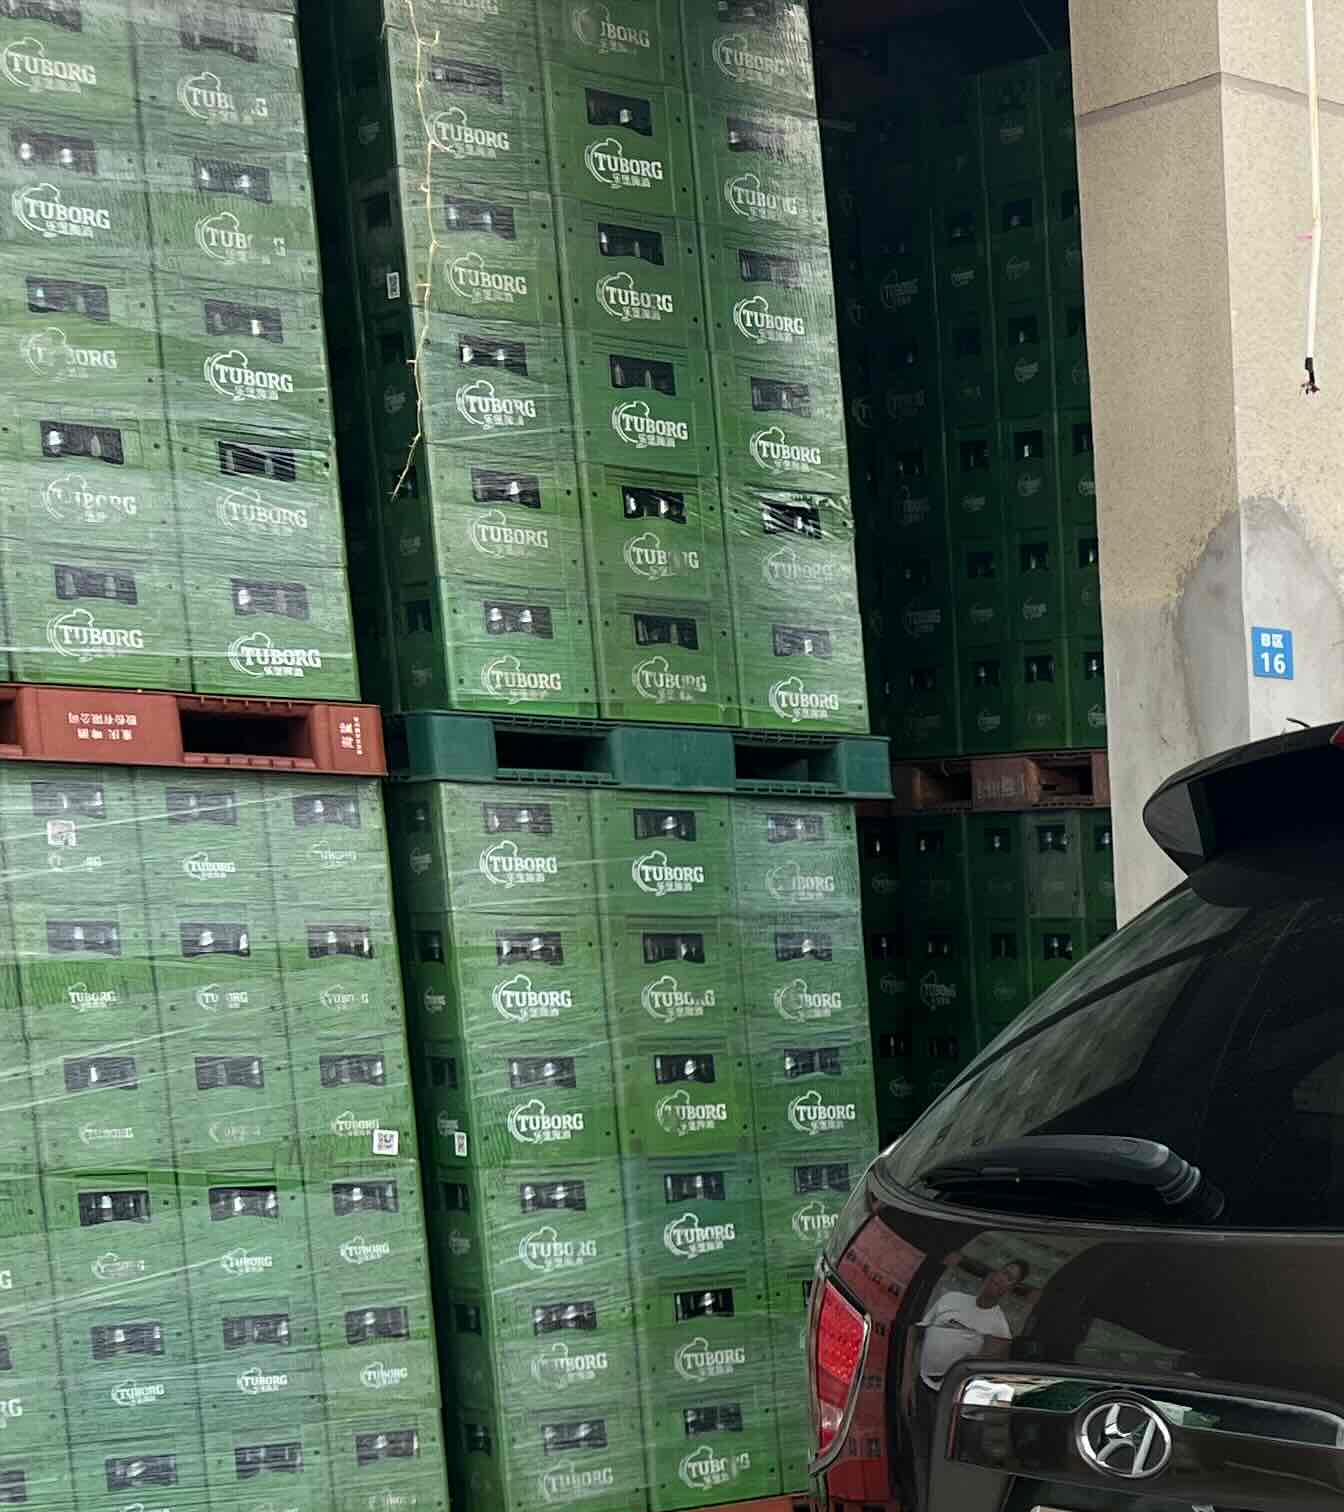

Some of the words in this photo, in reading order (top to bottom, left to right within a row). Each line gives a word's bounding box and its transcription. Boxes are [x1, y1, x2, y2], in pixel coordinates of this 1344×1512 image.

[11, 56, 96, 85] TUBORG
[721, 47, 785, 74] TUBORG
[436, 119, 509, 150] TUBORG
[594, 152, 662, 179] TUBORG
[26, 199, 110, 229] TUBORG
[455, 266, 527, 294] TUBORG
[743, 309, 804, 334] TUBORG
[215, 366, 293, 393] TUBORG
[466, 395, 535, 417] TUBORG
[621, 414, 688, 439] TUBORG
[759, 441, 820, 464] TUBORG
[477, 525, 548, 547] TUBORG
[62, 624, 143, 647] TUBORG
[241, 645, 321, 668] TUBORG
[1261, 652, 1286, 674] 16
[490, 671, 561, 691] TUBORG
[778, 692, 838, 710] TUBORG
[490, 856, 557, 874] TUBORG
[641, 865, 704, 883] TUBORG
[502, 991, 571, 1008] TUBORG
[516, 1113, 583, 1131] TUBORG
[793, 1104, 855, 1121] TUBORG
[671, 1225, 735, 1241] TUBORG
[682, 1349, 744, 1365] TUBORG
[243, 1374, 287, 1386] TUBORG
